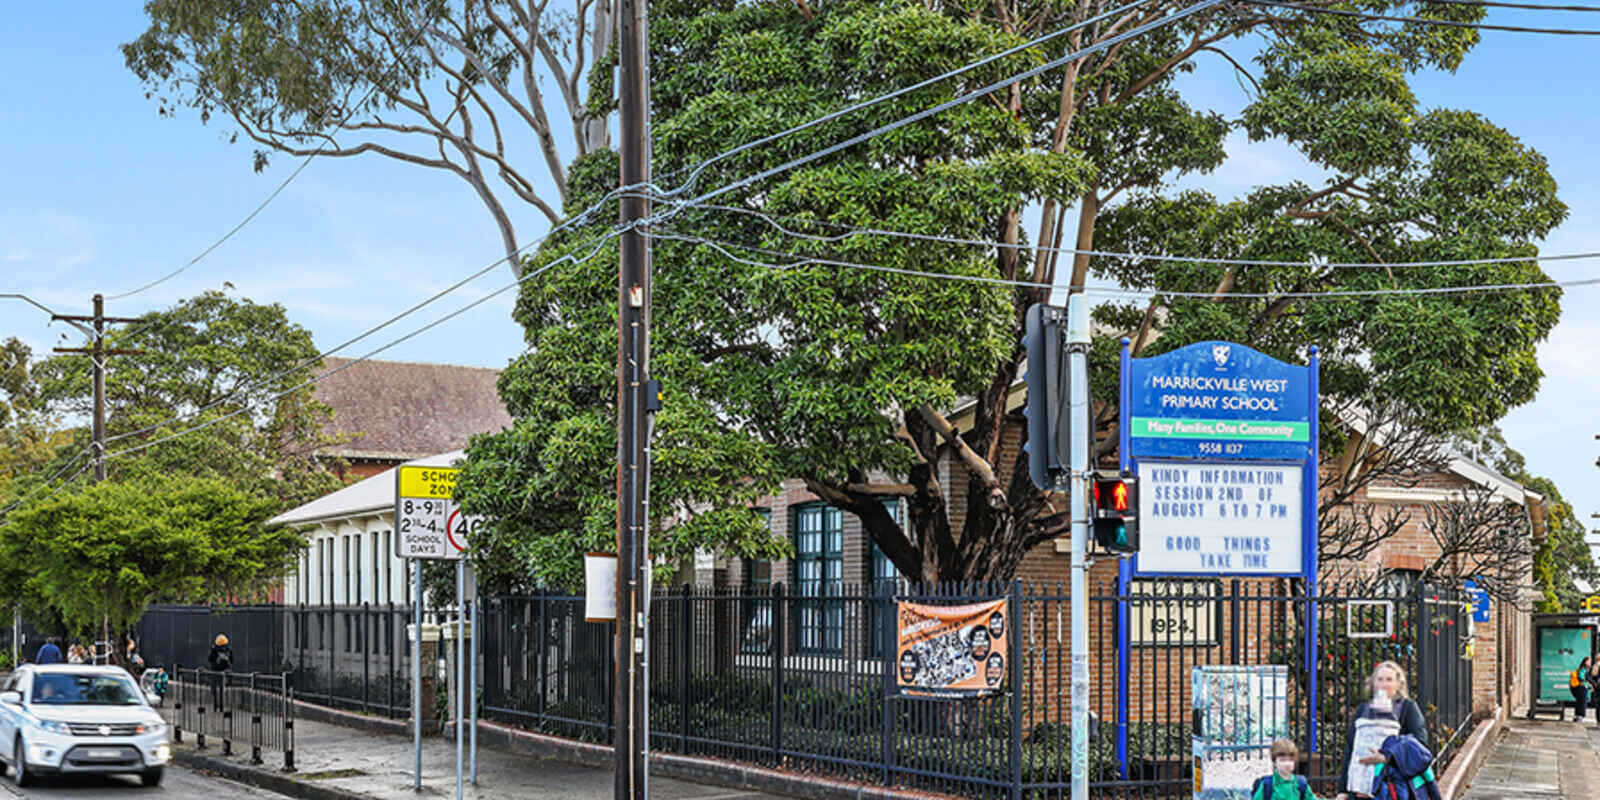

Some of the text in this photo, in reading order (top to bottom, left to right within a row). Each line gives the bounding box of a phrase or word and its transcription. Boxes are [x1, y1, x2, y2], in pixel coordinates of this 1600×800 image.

[1152, 376, 1288, 393] MARRICKVILLE WEST
[1162, 394, 1279, 412] PRIMARY SCHOOL
[1148, 421, 1174, 435] Many
[1215, 422, 1238, 434] One
[1239, 424, 1294, 438] Community
[1199, 443, 1223, 454] 9558
[421, 471, 457, 482] SCHO
[1152, 469, 1284, 485] KINDY INFORMATION
[1155, 487, 1273, 503] SESSION 2ND OF
[1153, 504, 1287, 519] AUGUST 6 TO 7 PM
[406, 535, 441, 544] SCHOOL
[1166, 536, 1271, 552] GOOD THINGS
[410, 545, 436, 553] DAYS
[1200, 554, 1269, 569] TAKE TIME
